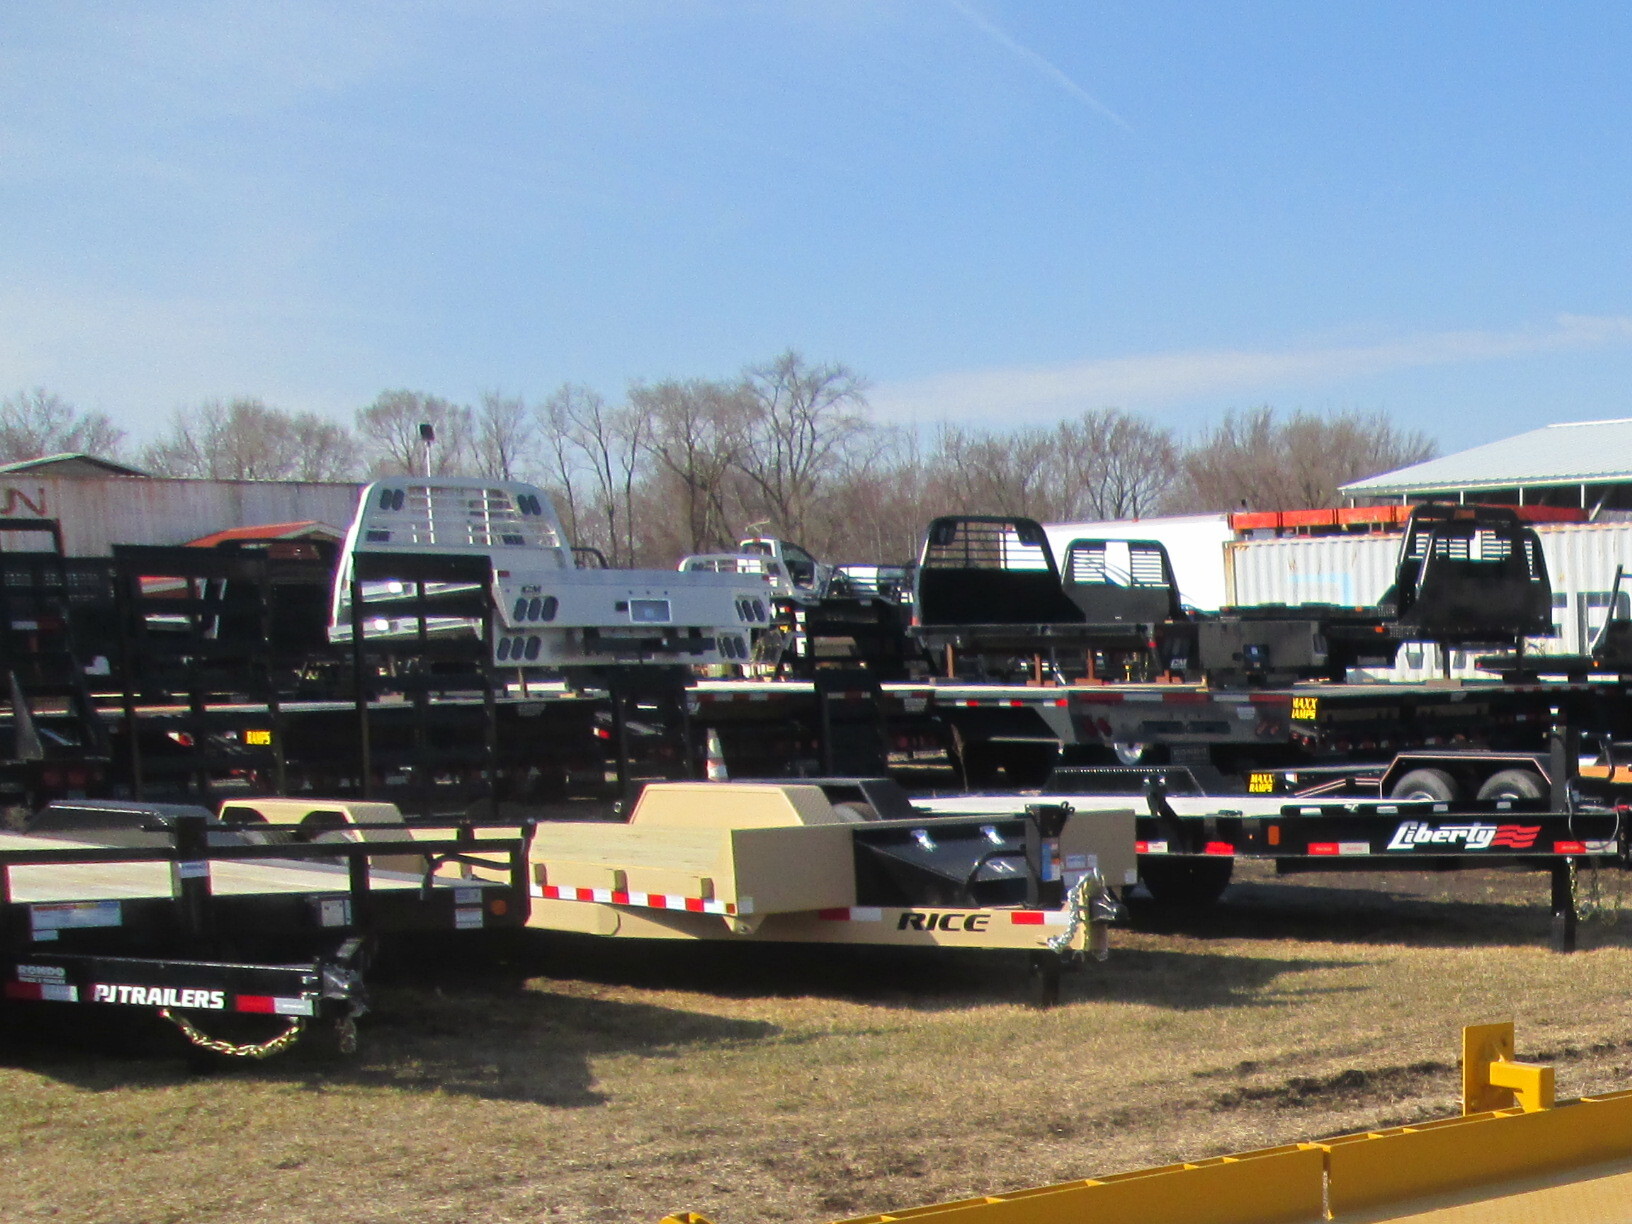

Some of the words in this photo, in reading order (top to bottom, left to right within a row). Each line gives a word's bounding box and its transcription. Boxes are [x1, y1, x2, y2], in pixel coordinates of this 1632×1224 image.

[1249, 783, 1273, 793] RAMPS
[1386, 820, 1498, 850] Liberty
[897, 913, 991, 932] RICE
